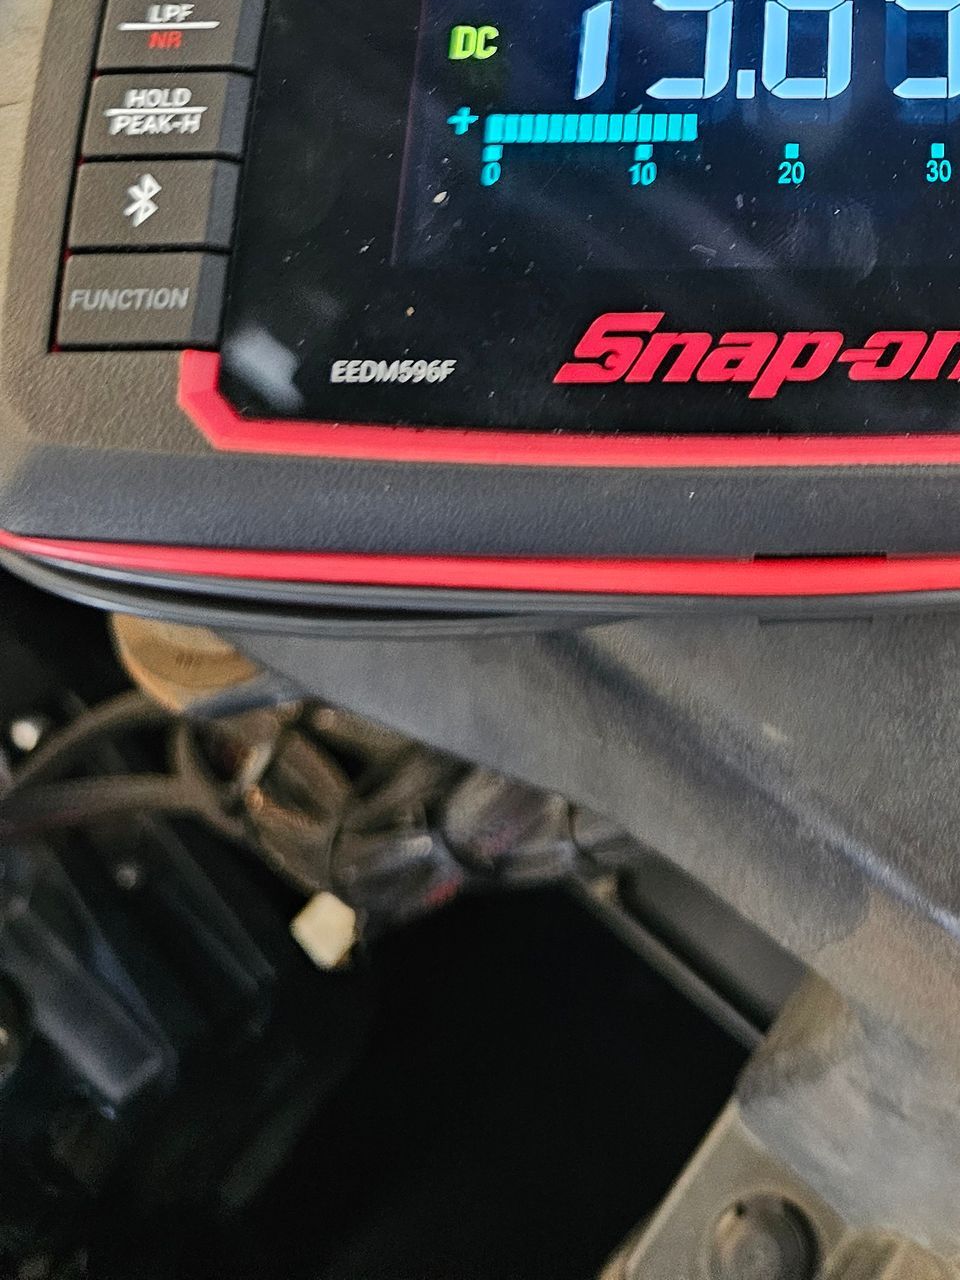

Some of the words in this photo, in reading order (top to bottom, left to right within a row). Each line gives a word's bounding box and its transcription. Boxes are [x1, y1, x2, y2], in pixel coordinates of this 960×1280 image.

[148, 4, 195, 23] LPF
[147, 31, 183, 49] NR
[448, 25, 500, 60] DC
[124, 86, 192, 108] HOLD
[109, 113, 202, 135] PEAK-H
[480, 161, 502, 187] 0
[628, 161, 658, 187] 10
[777, 161, 806, 185] 20
[926, 159, 952, 183] 30
[68, 286, 190, 312] FUNCTION
[330, 357, 457, 385] EEDM596F
